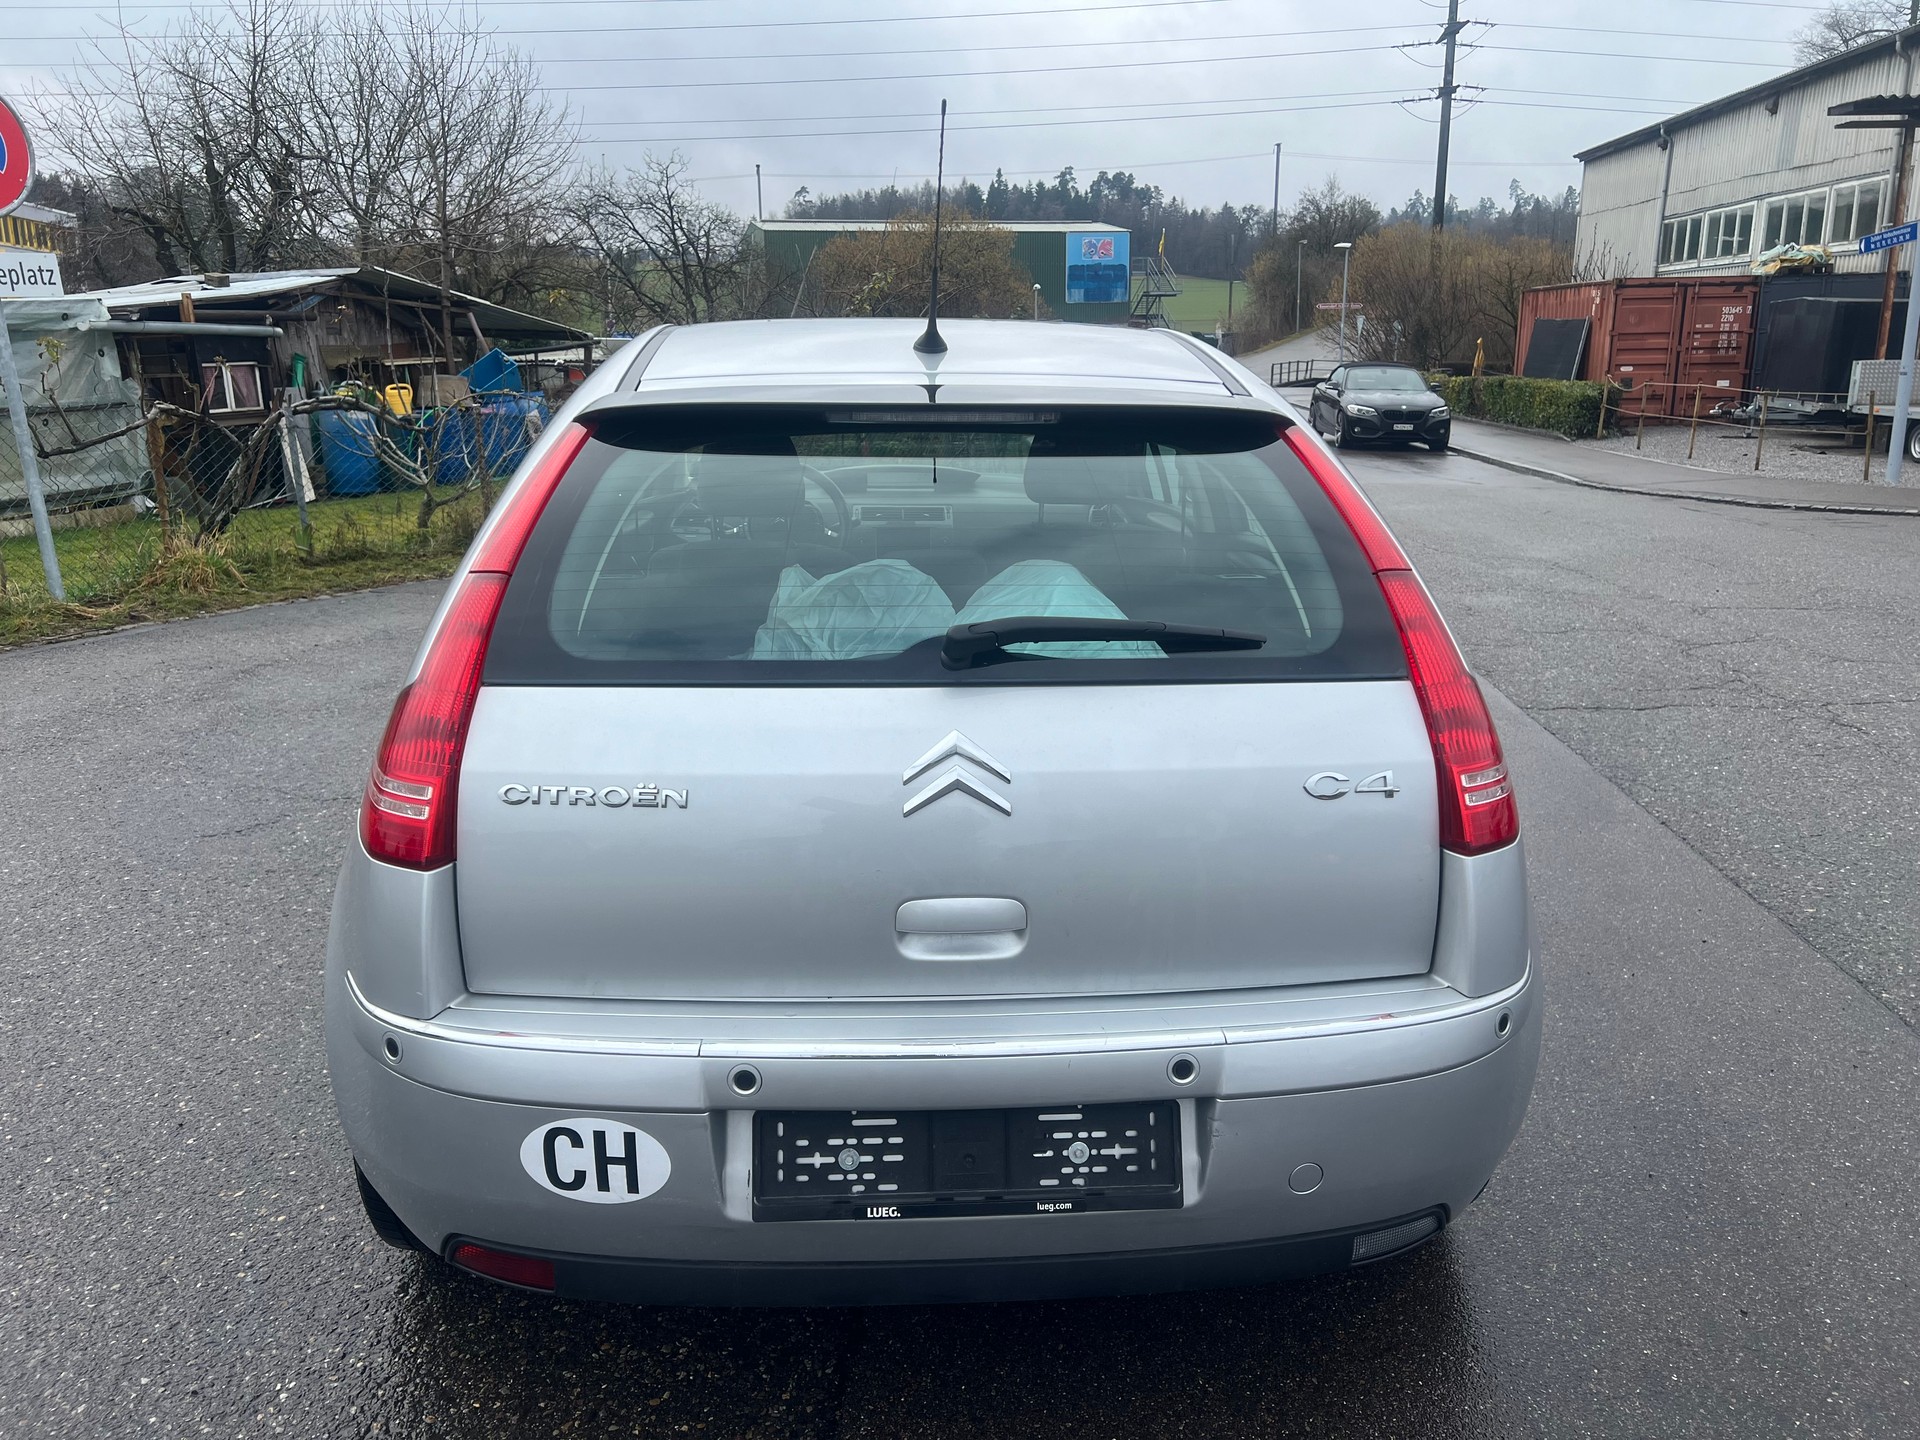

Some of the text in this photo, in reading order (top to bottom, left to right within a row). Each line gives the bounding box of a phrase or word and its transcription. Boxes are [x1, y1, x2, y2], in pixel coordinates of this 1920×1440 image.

[1722, 306, 1743, 314] 503645
[1720, 314, 1734, 322] 2210
[1303, 769, 1400, 800] C4
[497, 783, 689, 809] CITROËN
[543, 1127, 640, 1194] CH
[867, 1207, 901, 1218] LUEG.
[1036, 1202, 1073, 1212] lueg.com
